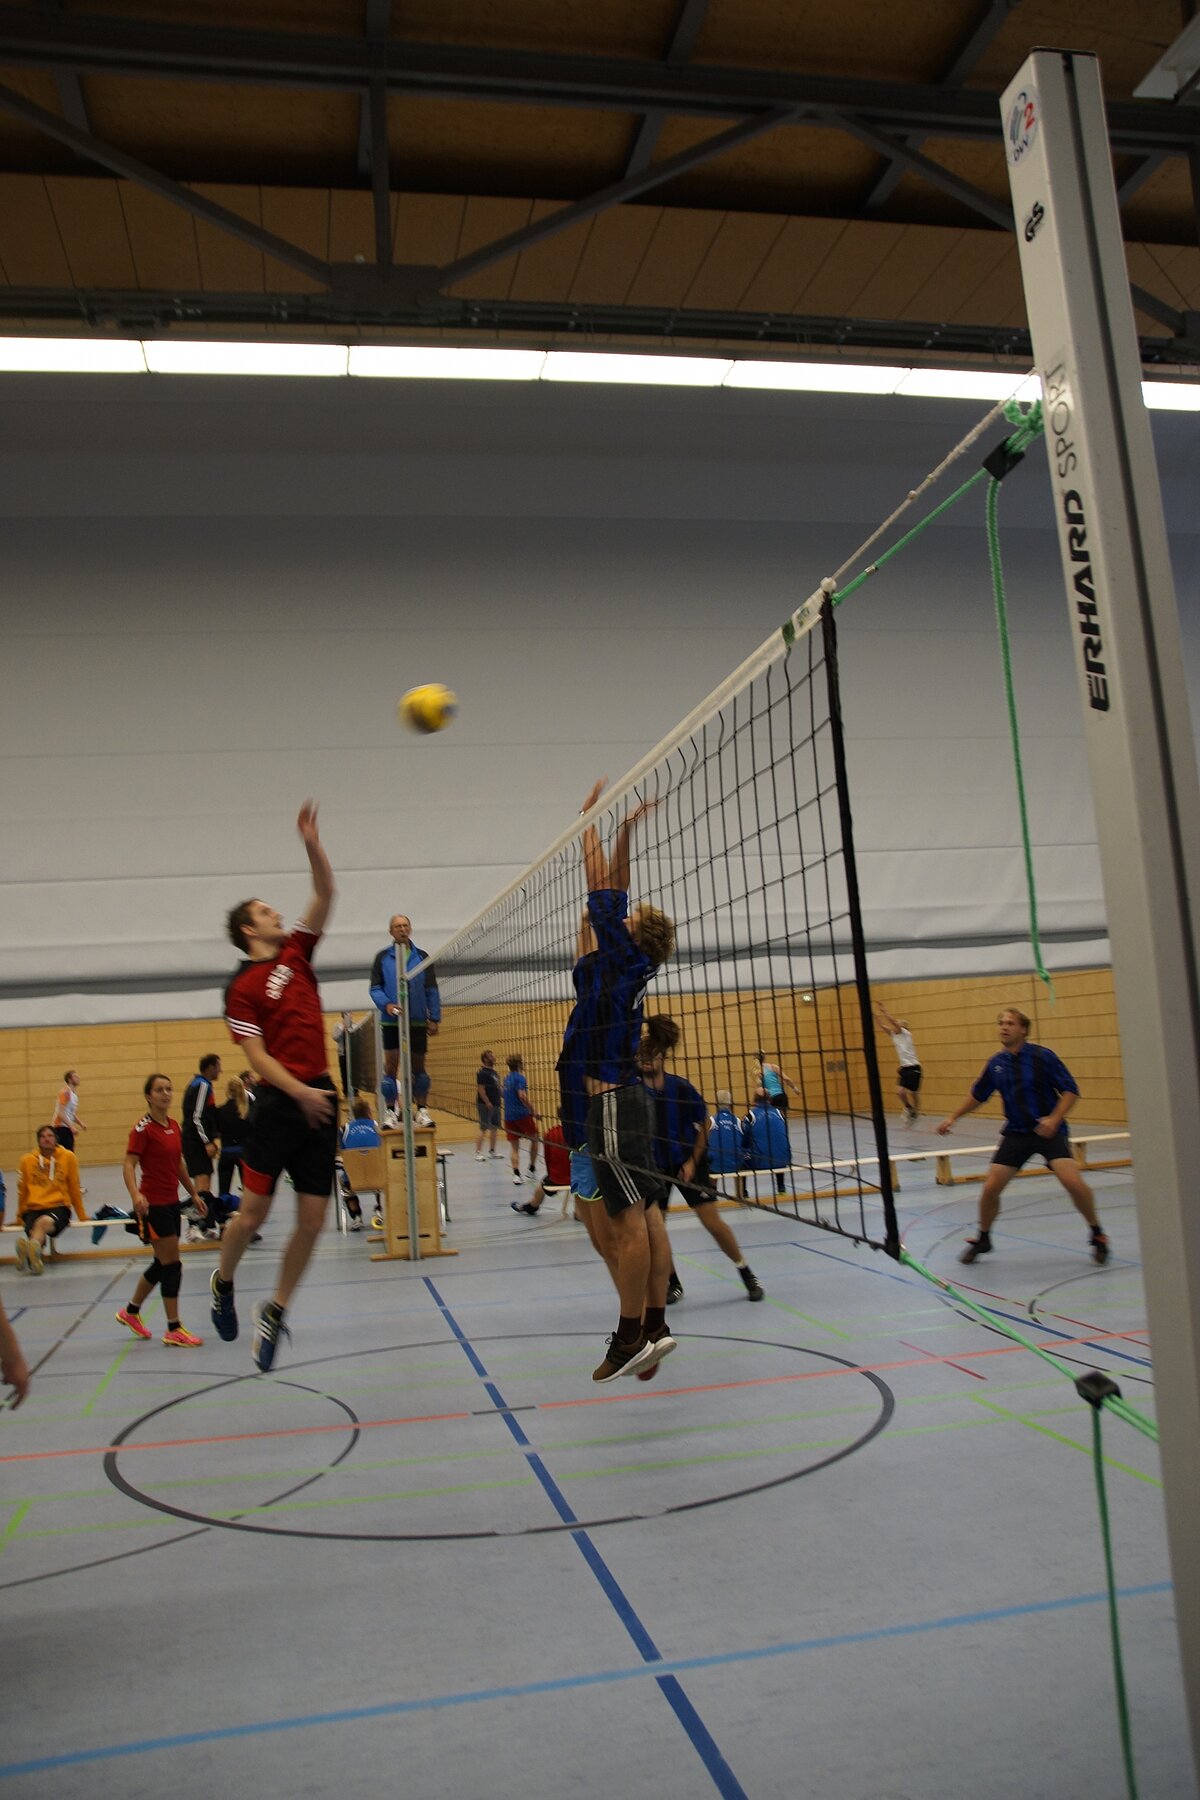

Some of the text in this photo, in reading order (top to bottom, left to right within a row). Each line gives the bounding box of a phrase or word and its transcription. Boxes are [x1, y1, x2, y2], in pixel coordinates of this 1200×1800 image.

[1025, 201, 1044, 242] GS
[1045, 362, 1110, 712] ERHARD SPORT
